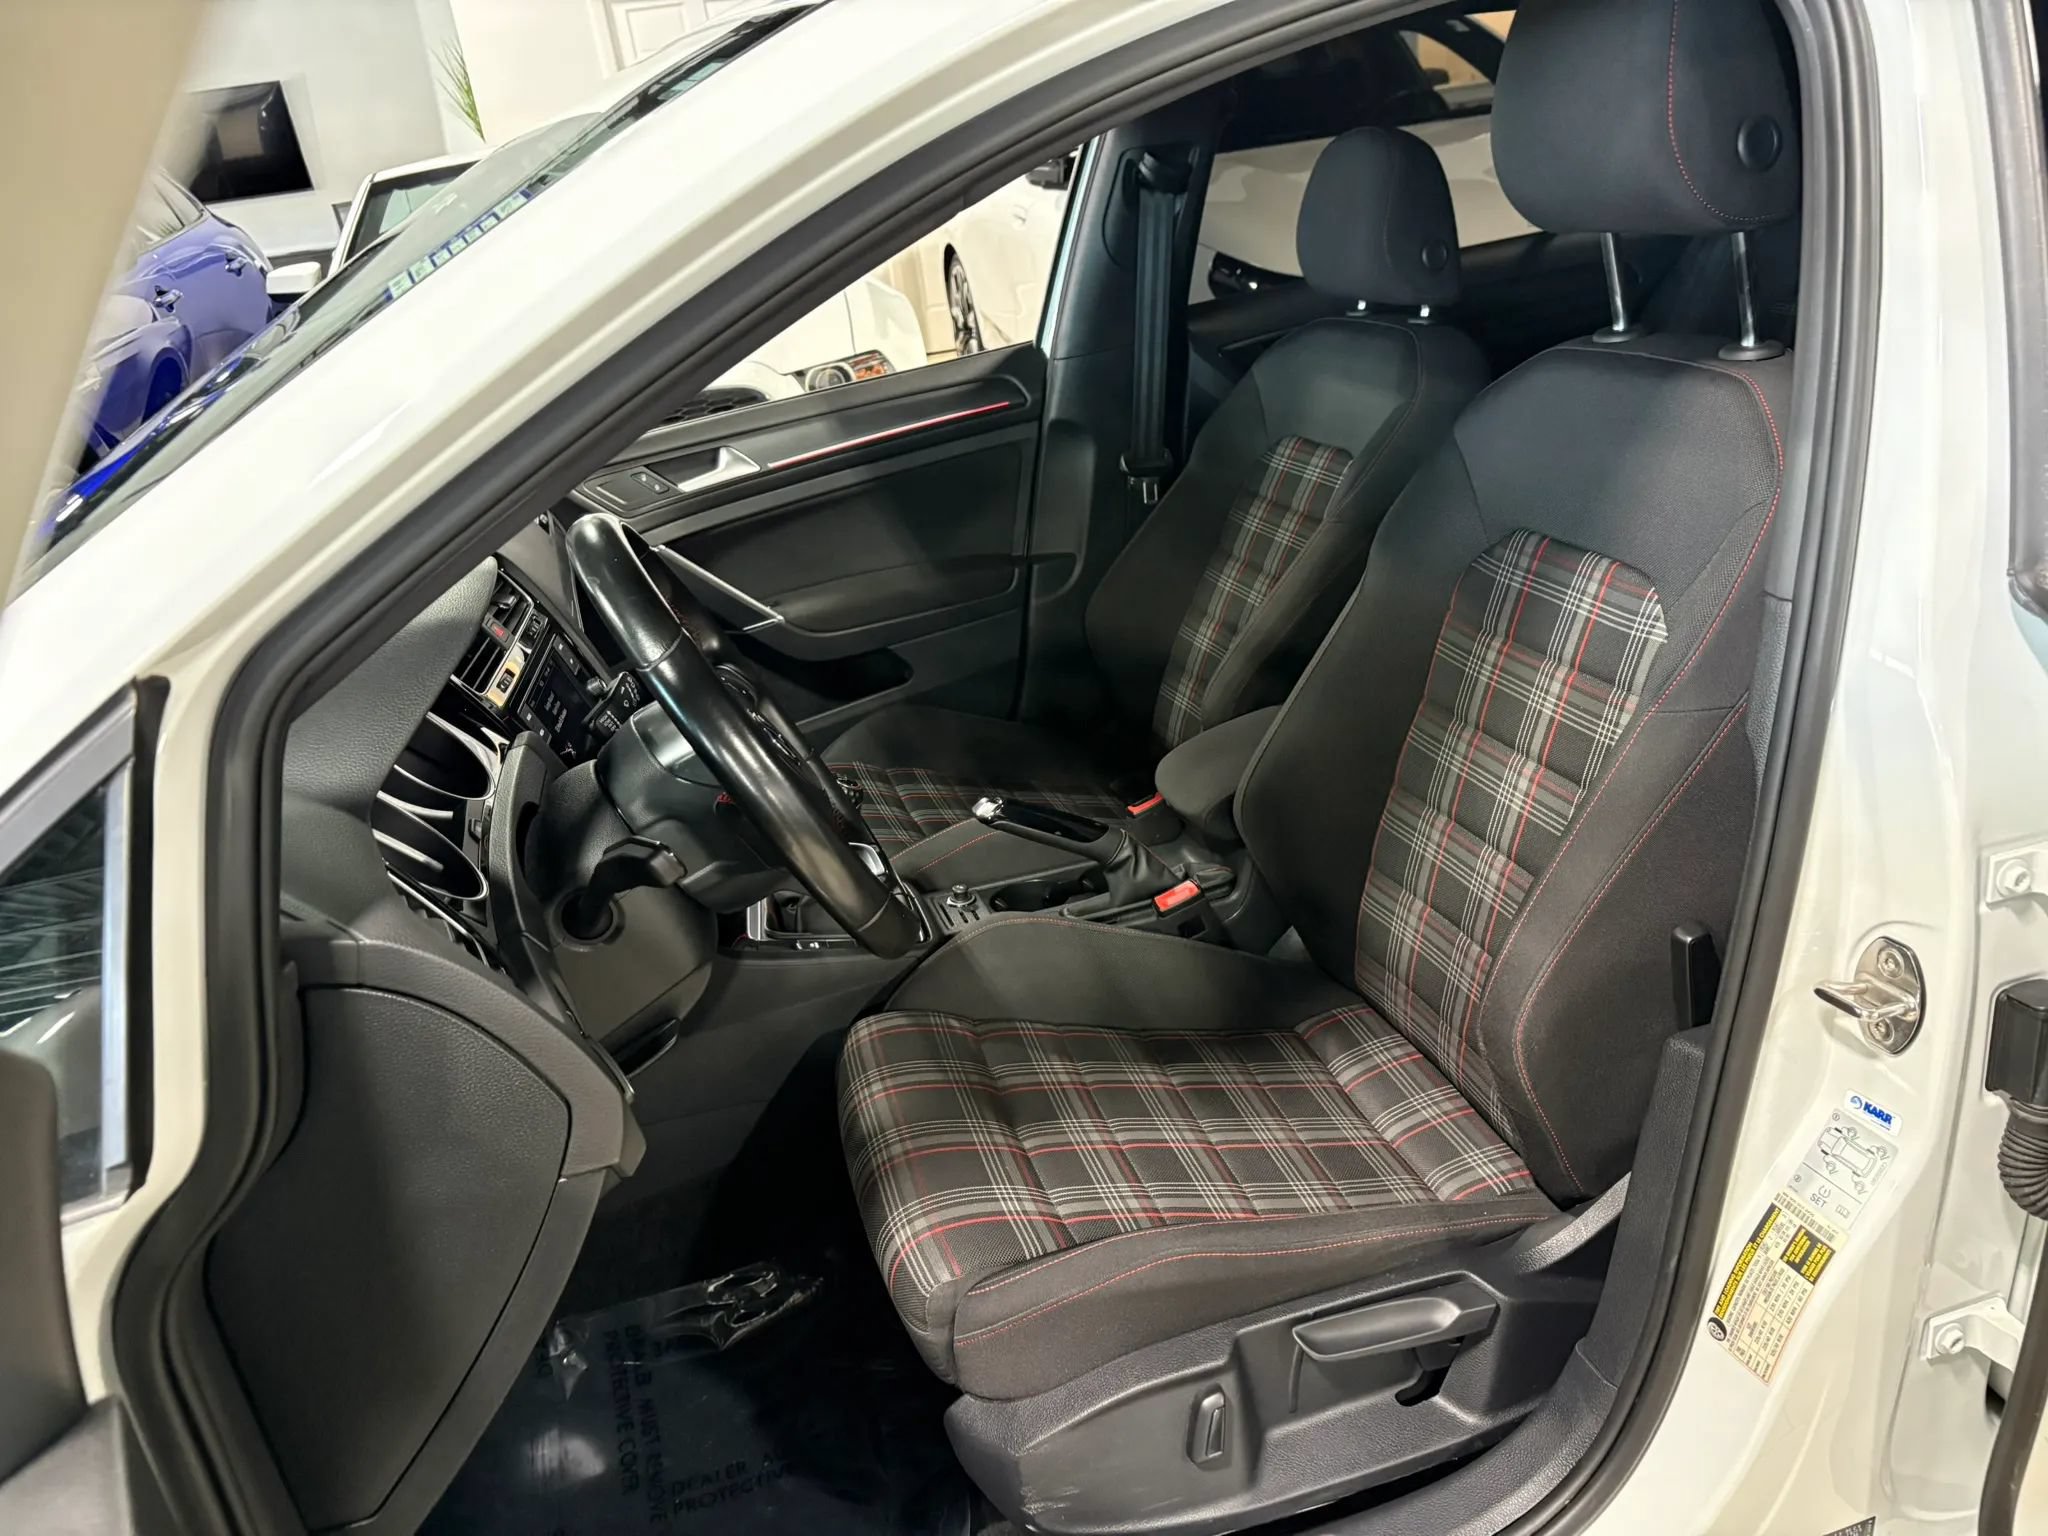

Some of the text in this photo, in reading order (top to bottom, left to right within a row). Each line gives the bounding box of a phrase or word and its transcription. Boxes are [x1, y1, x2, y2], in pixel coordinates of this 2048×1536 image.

[1863, 1101, 1893, 1124] KARR
[1808, 1193, 1827, 1208] SET
[671, 1463, 785, 1518] PROTECTIV
